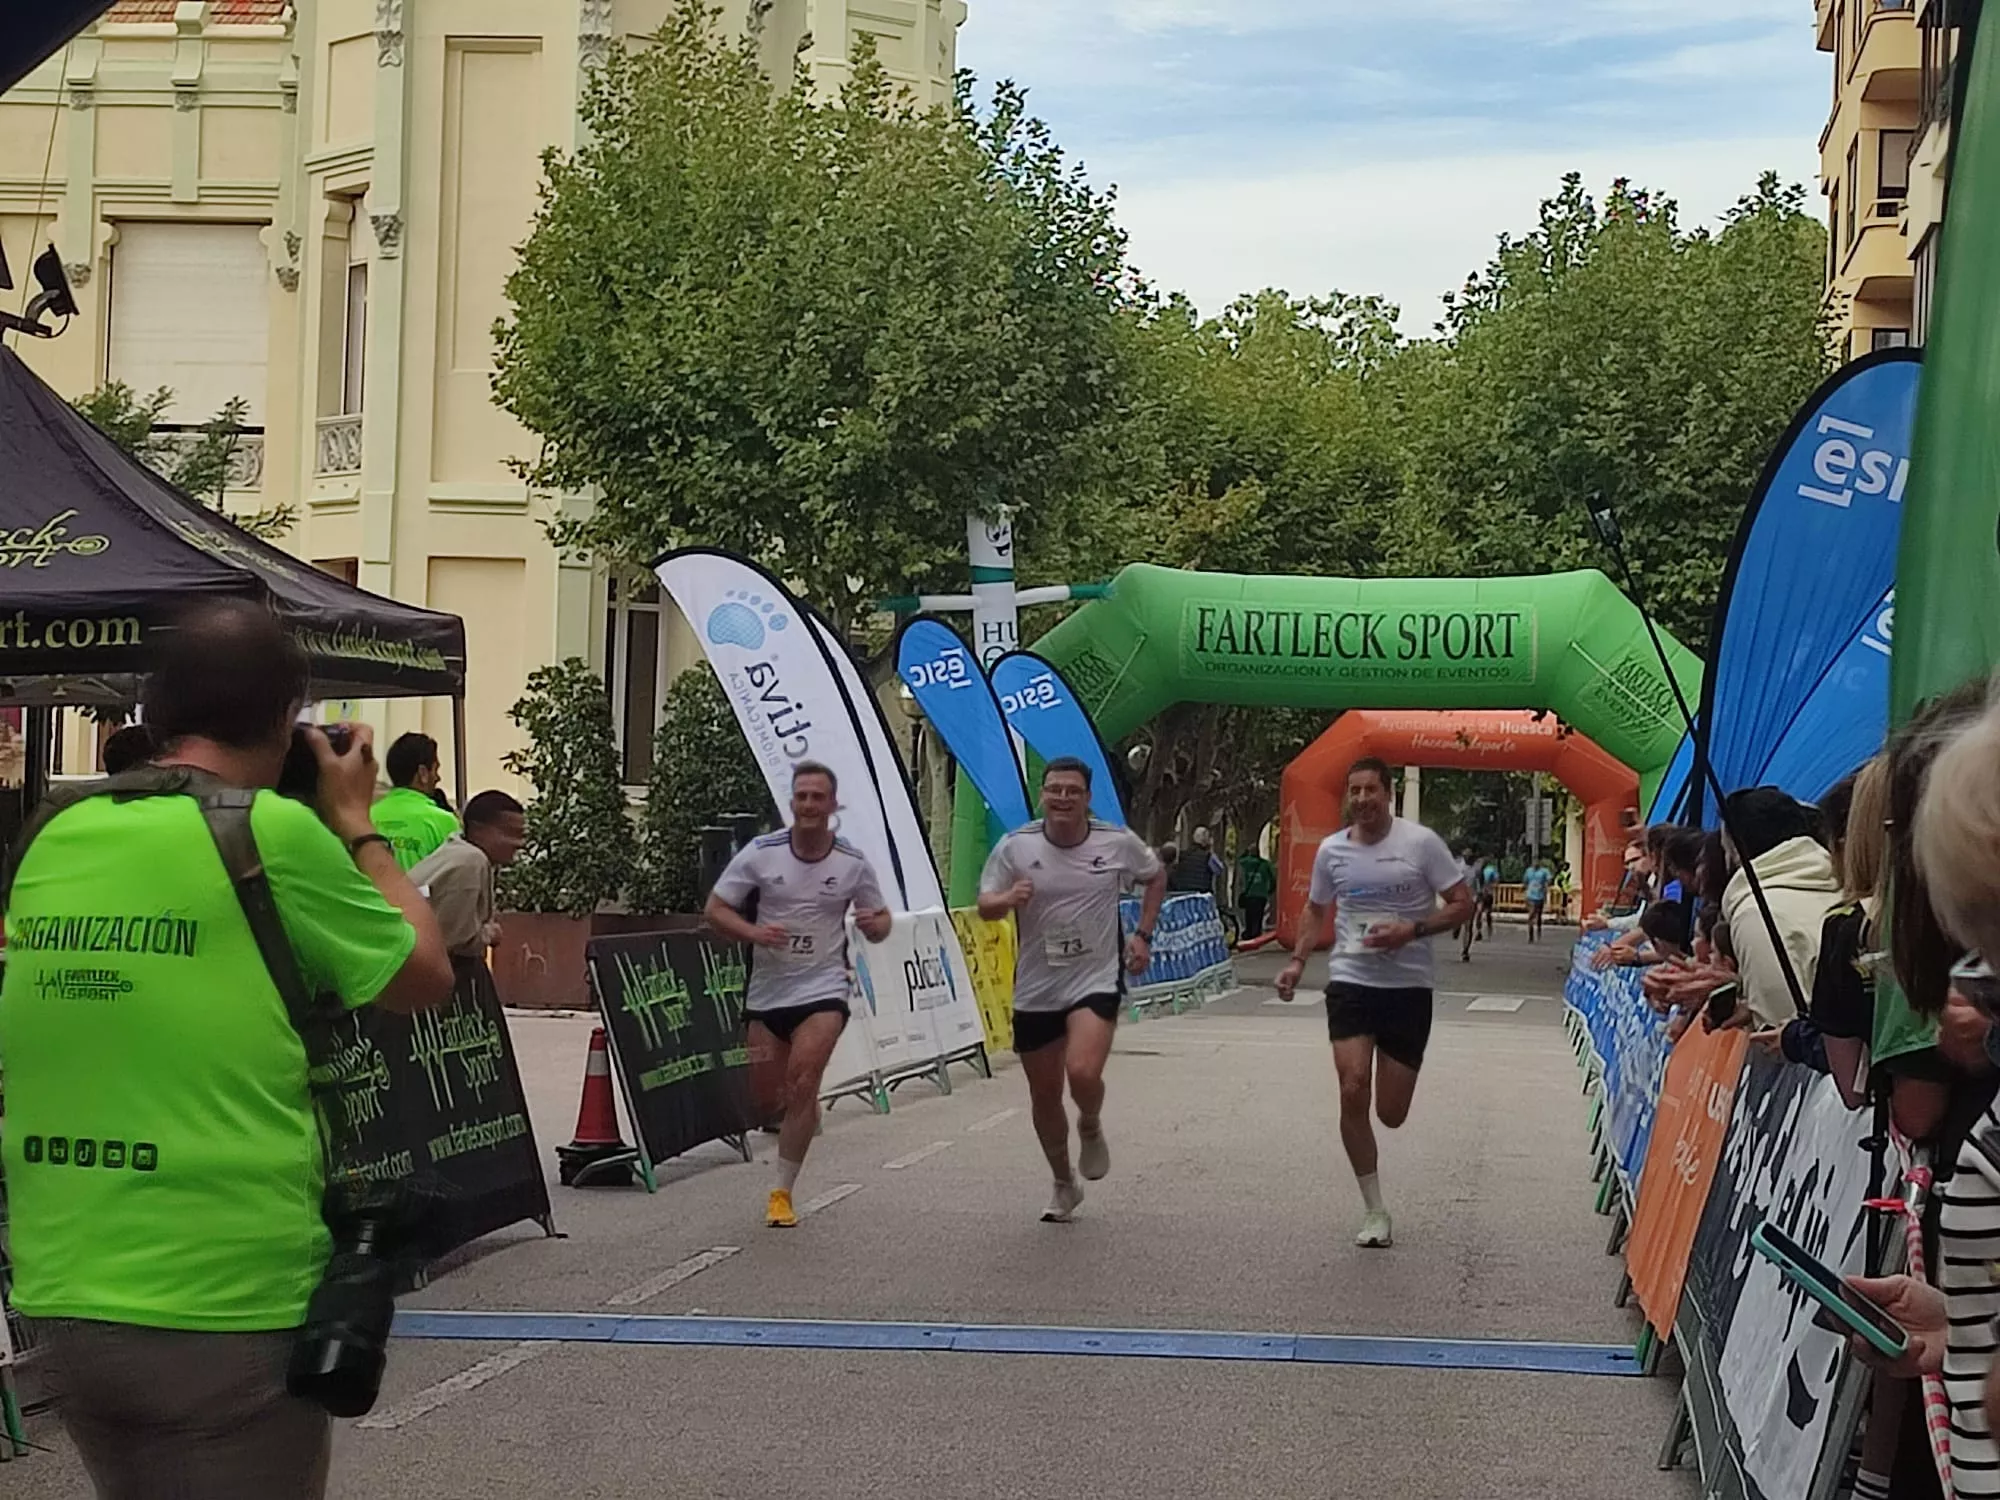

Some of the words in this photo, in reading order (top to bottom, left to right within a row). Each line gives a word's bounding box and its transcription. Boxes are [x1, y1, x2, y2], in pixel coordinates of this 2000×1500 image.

[1195, 606, 1388, 660] FARTLECK
[1397, 612, 1521, 661] SPORT
[1500, 720, 1553, 735] Huesca
[790, 935, 812, 949] 75
[1061, 939, 1083, 954] 73
